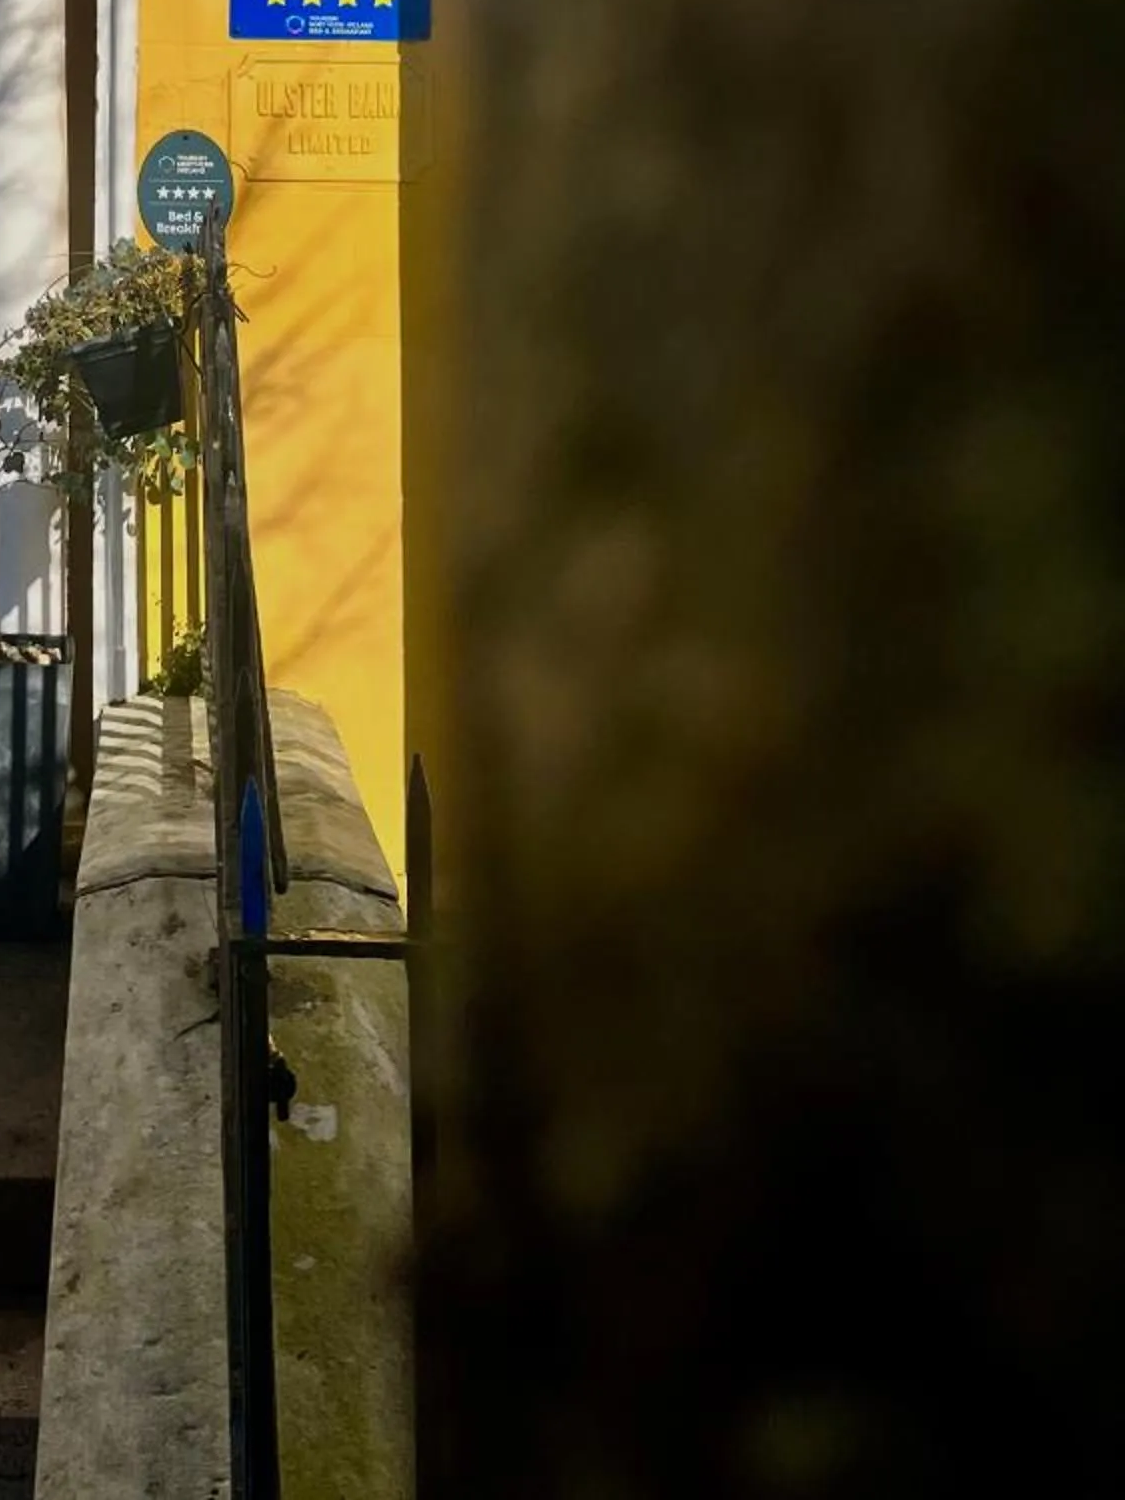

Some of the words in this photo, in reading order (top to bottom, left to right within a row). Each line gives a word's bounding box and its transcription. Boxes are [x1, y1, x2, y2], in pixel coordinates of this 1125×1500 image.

[256, 82, 337, 119] ULSTER
[348, 82, 400, 119] BAN
[287, 133, 372, 155] LIMITED
[168, 210, 192, 222] Bed
[193, 211, 204, 223] &
[156, 222, 202, 235] Breakf
